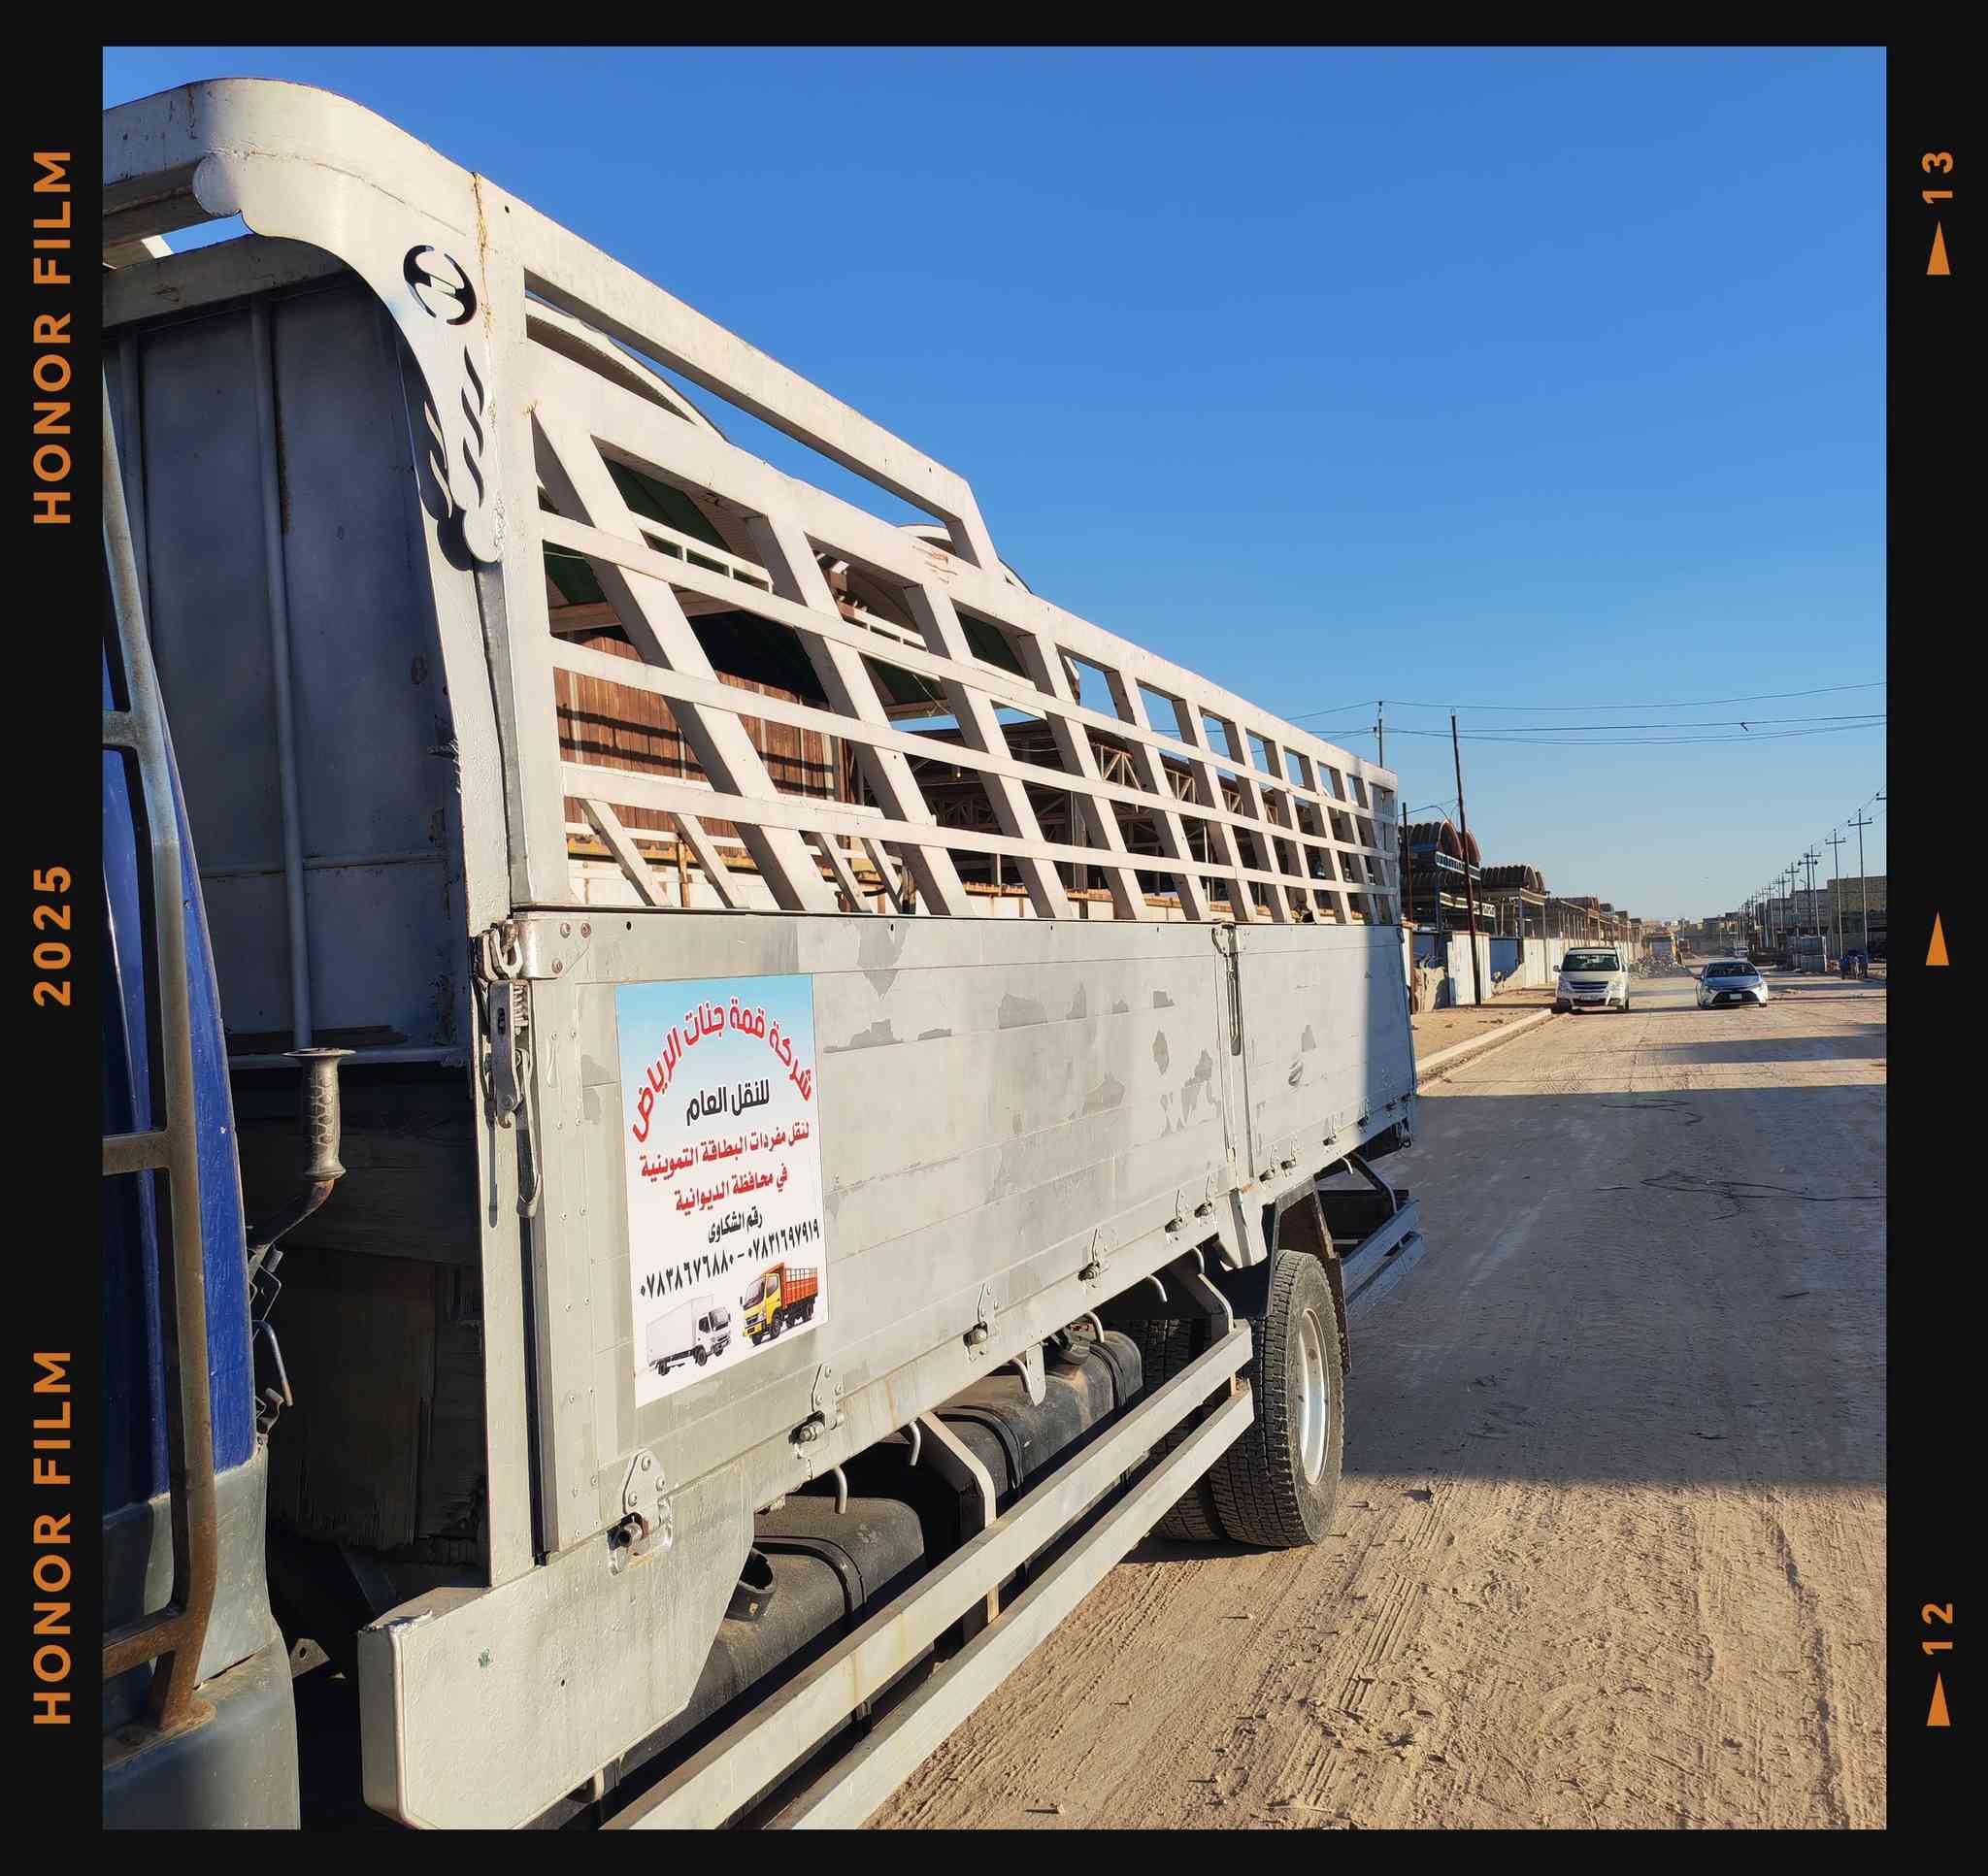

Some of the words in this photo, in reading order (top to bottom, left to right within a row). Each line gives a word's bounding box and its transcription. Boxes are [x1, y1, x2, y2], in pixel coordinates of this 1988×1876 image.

[683, 1002, 725, 1046] جنات
[729, 998, 765, 1039] قمة
[769, 1021, 812, 1102] شركة
[632, 1028, 683, 1142] الرياض
[731, 1079, 770, 1116] للنقل
[686, 1086, 728, 1126] العام
[700, 1138, 747, 1161] البطاقة
[749, 1127, 786, 1152] مفردات
[788, 1122, 810, 1146] لنقل
[640, 1149, 699, 1182] التموينية
[776, 1163, 788, 1193] في
[674, 1180, 730, 1216] الديوانية
[732, 1172, 774, 1196] محافظة
[708, 1211, 745, 1243] الشكاوى
[746, 1206, 763, 1233] رقم
